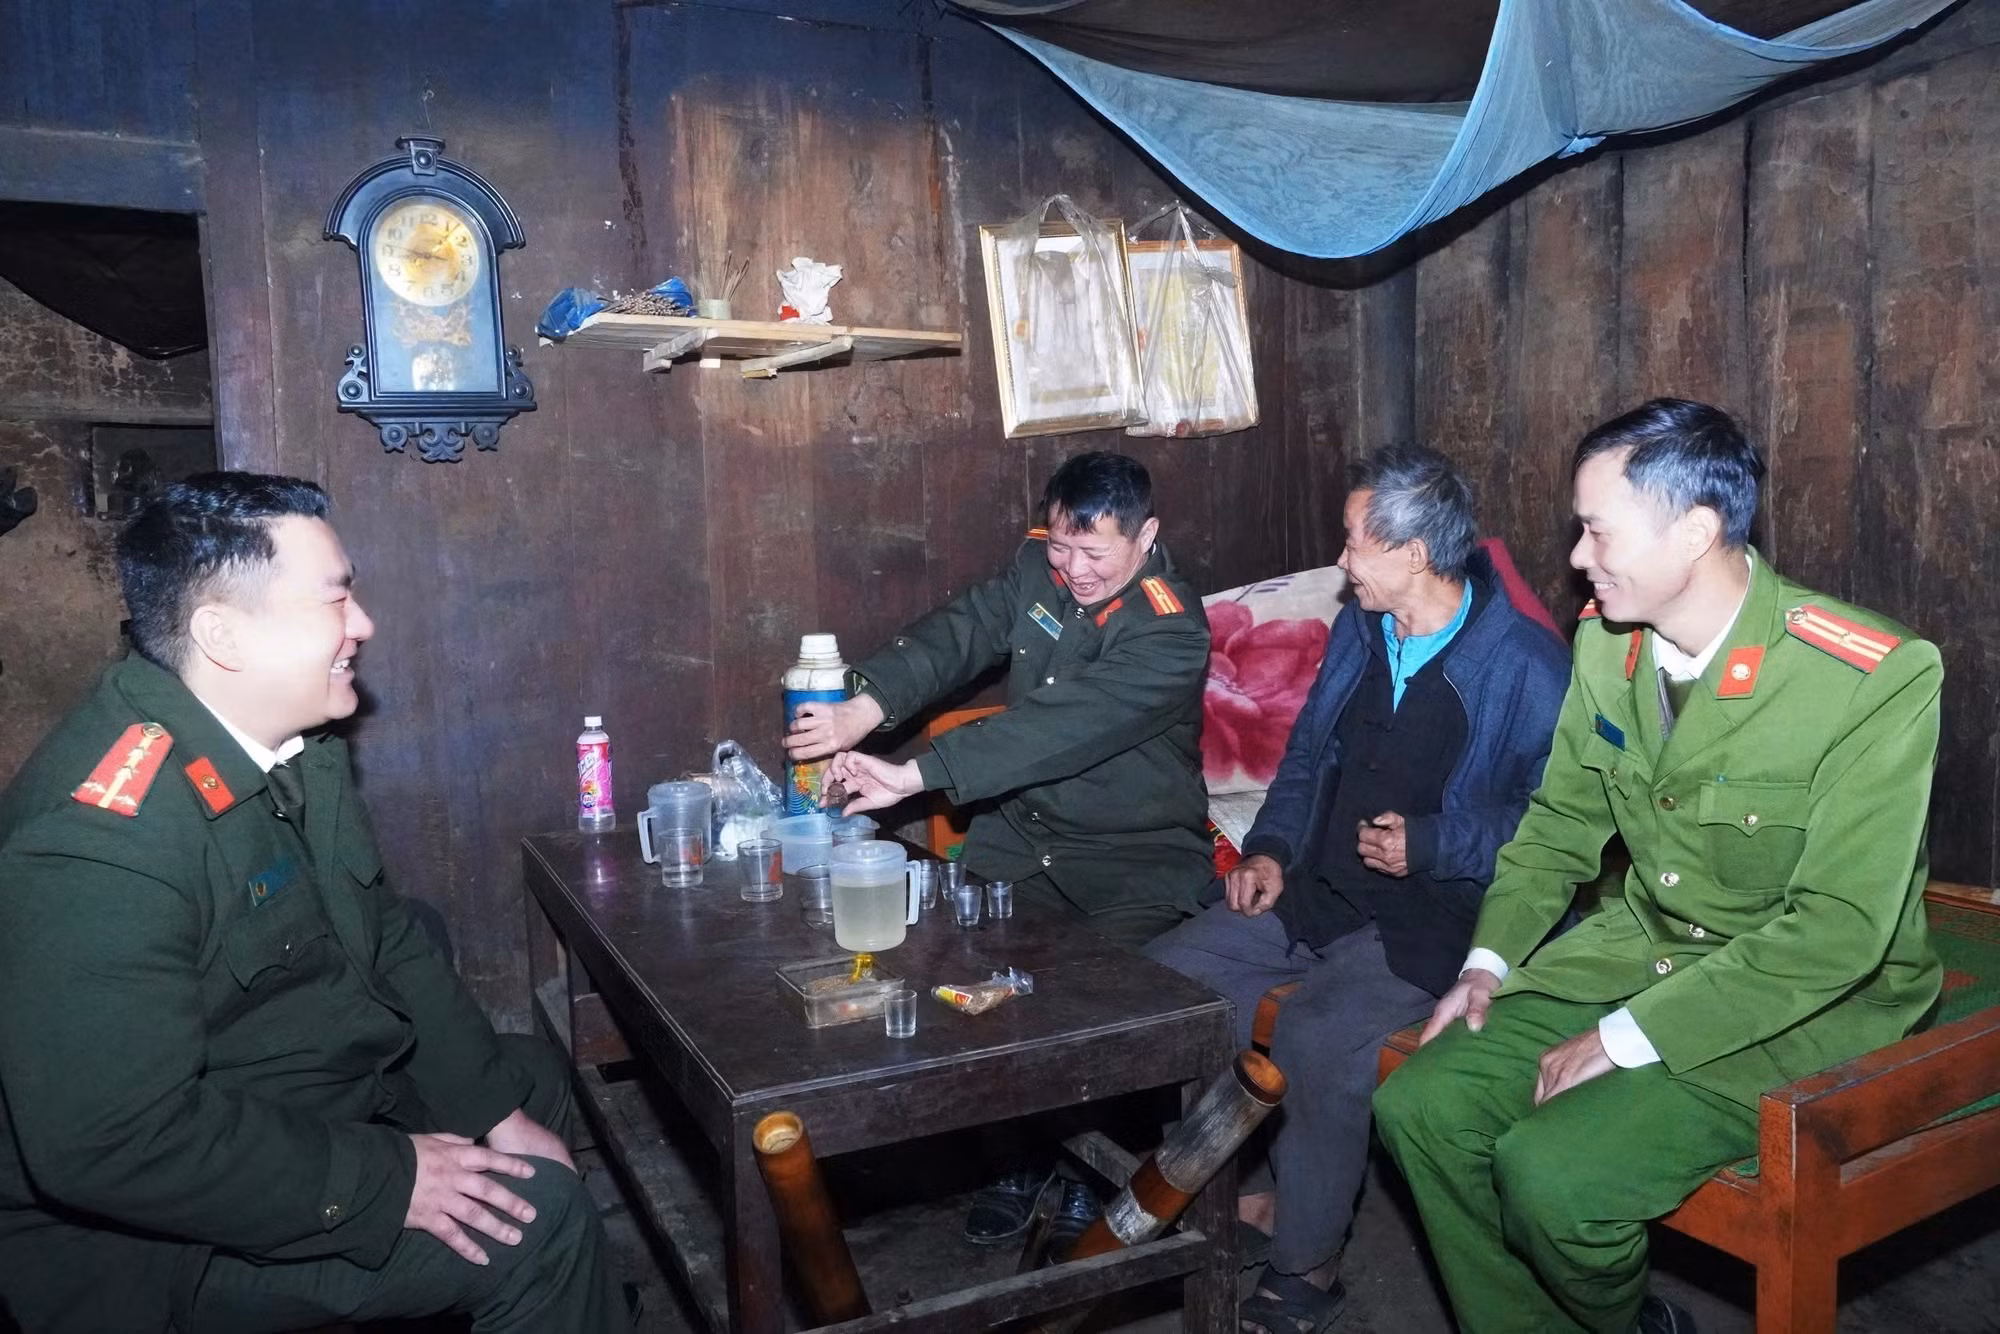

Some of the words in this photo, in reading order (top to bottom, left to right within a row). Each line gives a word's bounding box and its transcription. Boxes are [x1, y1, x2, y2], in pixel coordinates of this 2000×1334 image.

[402, 216, 414, 227] 11
[420, 213, 438, 226] 12
[388, 228, 402, 240] 10
[456, 235, 469, 248] 2
[461, 254, 473, 266] 3
[441, 282, 454, 295] 5
